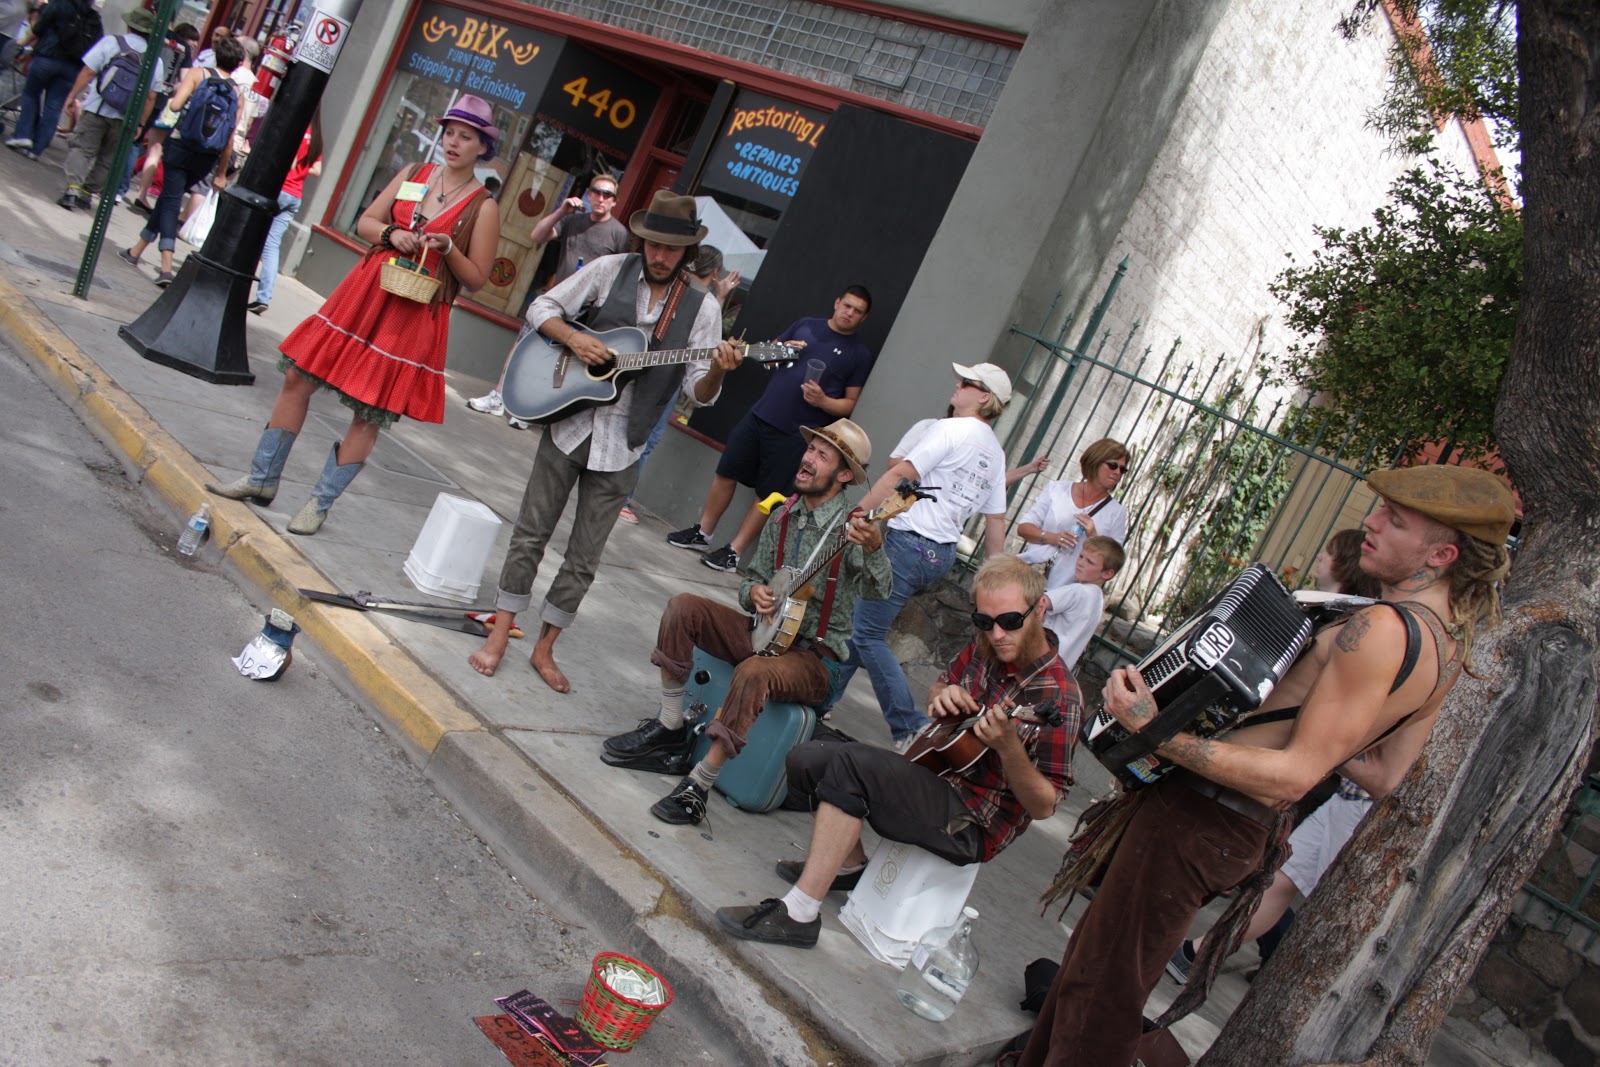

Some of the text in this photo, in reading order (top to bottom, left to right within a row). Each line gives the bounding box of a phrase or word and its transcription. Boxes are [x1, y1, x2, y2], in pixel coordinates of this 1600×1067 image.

[300, 47, 334, 65] TOW-AWAY
[304, 42, 336, 62] ACCESS
[314, 40, 331, 53] FIRE
[446, 47, 497, 73] FURNITURE
[409, 52, 455, 84] Stripping
[465, 71, 527, 109] Refinishing
[563, 76, 636, 129] 440
[727, 106, 814, 142] Restoring
[739, 141, 801, 175] REPAIRS
[730, 160, 800, 197] ANTIQUES
